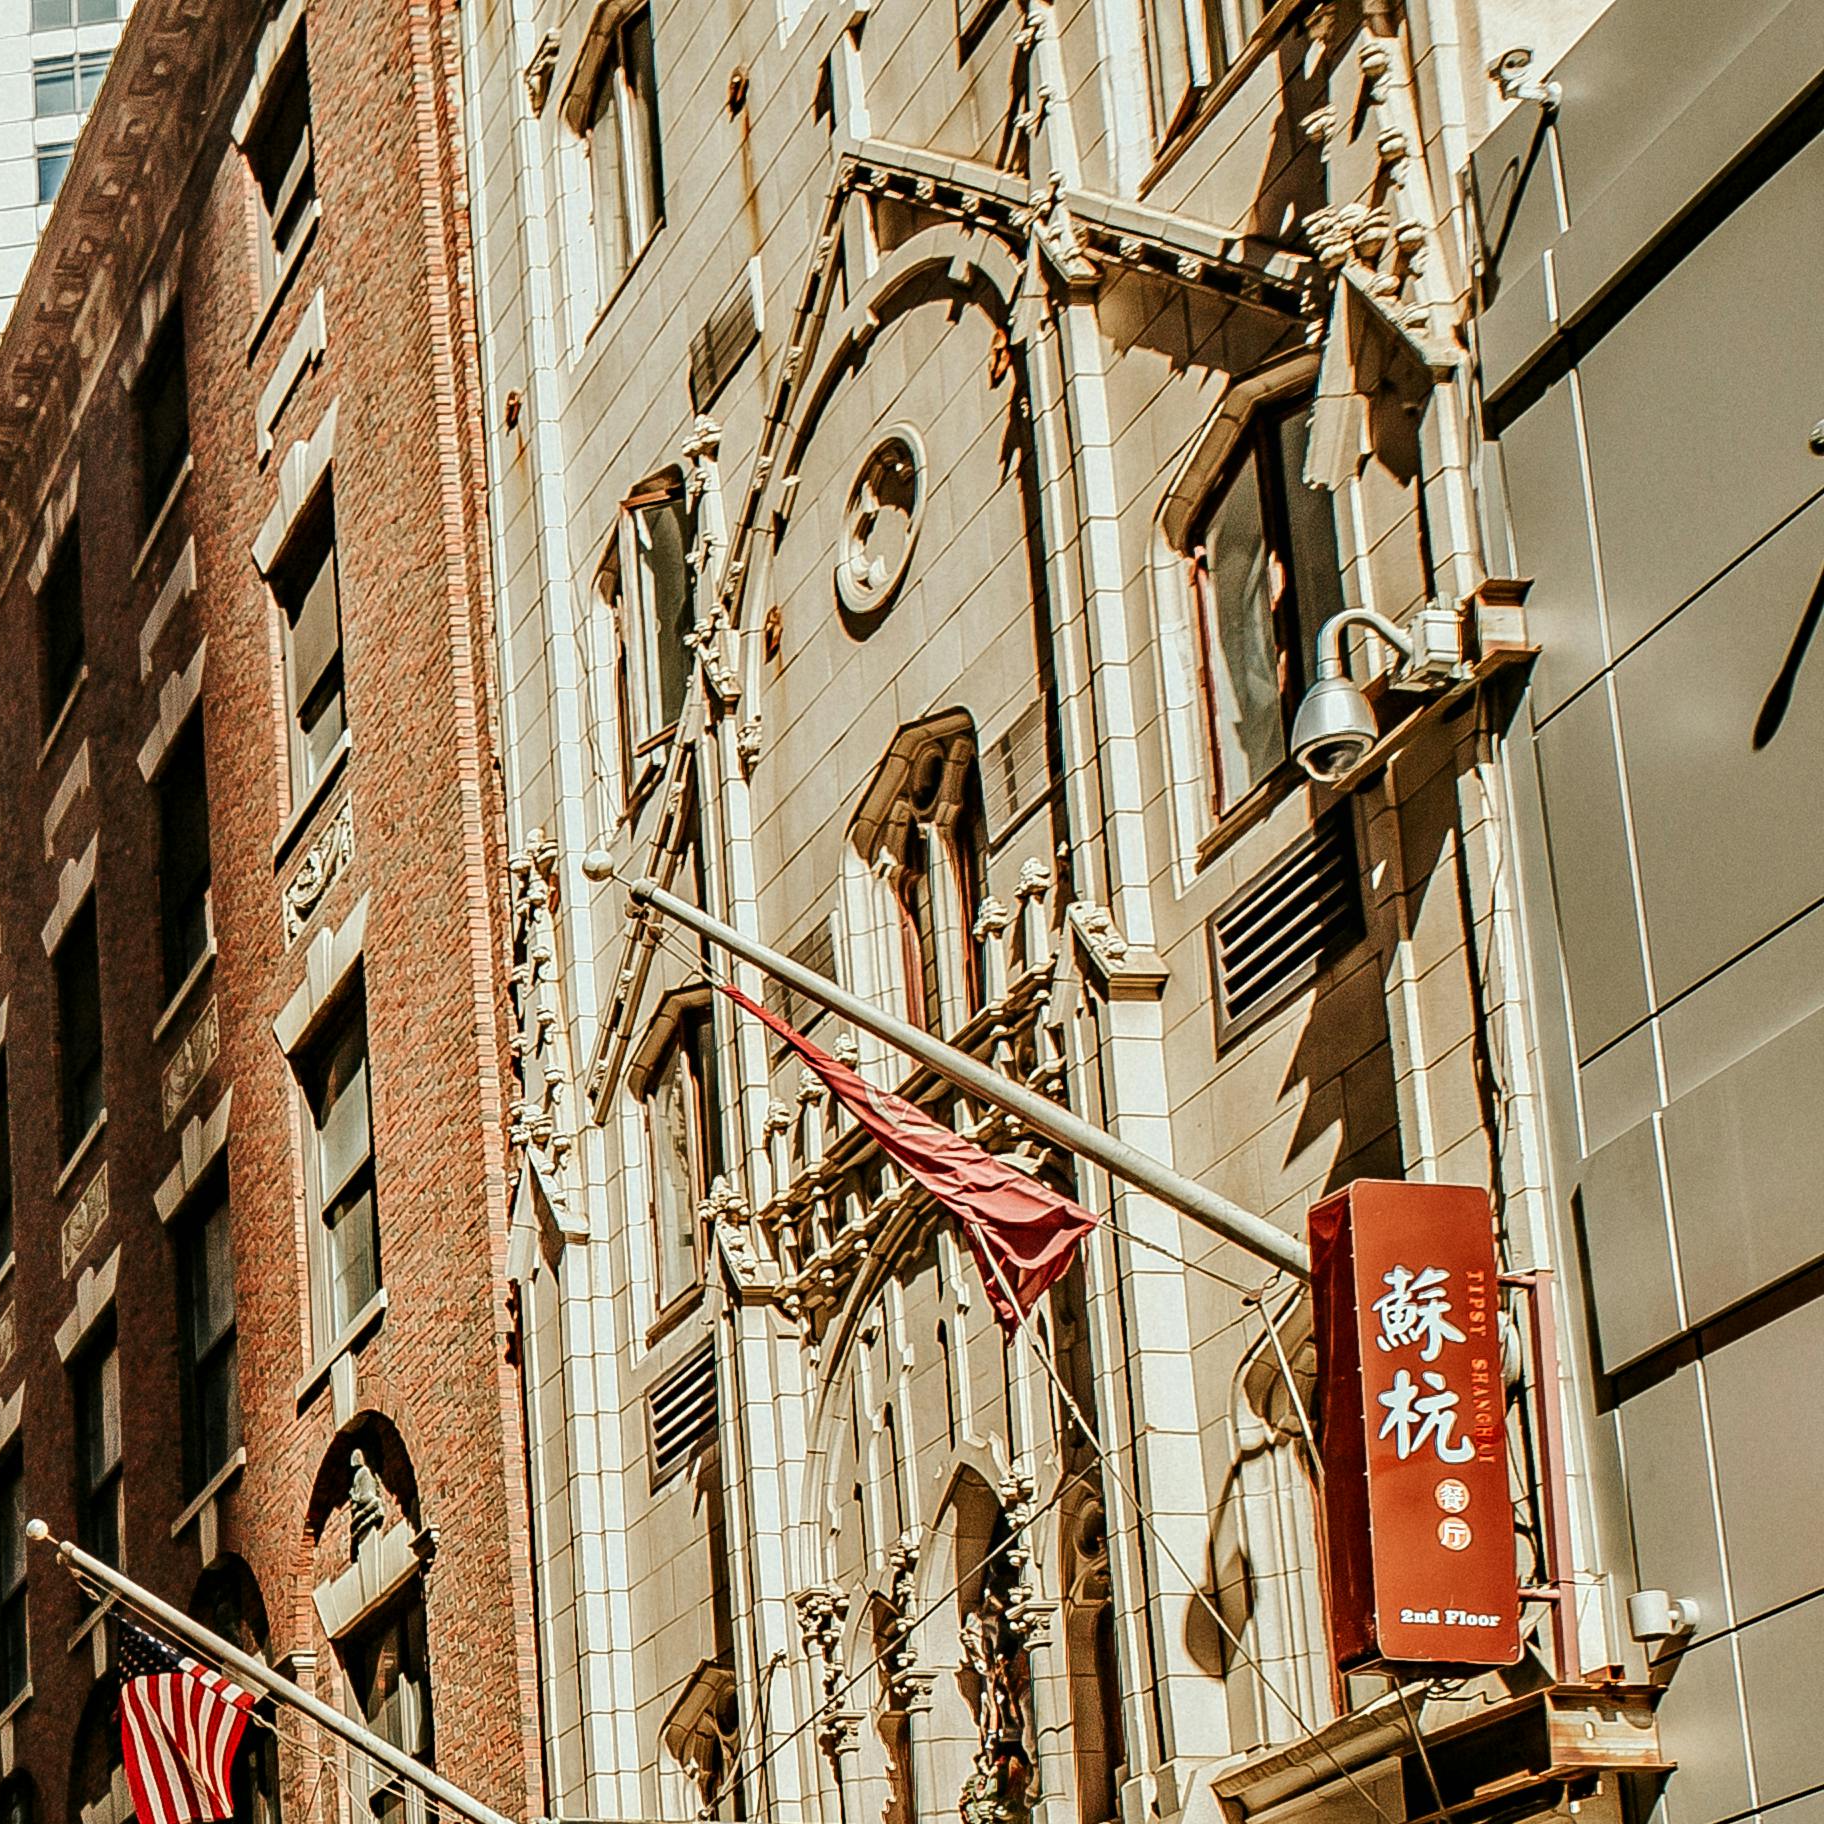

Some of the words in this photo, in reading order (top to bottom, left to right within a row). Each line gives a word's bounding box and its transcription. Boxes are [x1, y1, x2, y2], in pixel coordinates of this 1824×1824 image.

[1465, 1269, 1486, 1337] TIPSY
[1471, 1359, 1495, 1464] SHANGHAI
[1400, 1608, 1440, 1624] 2nd
[1444, 1609, 1501, 1627] Floor
